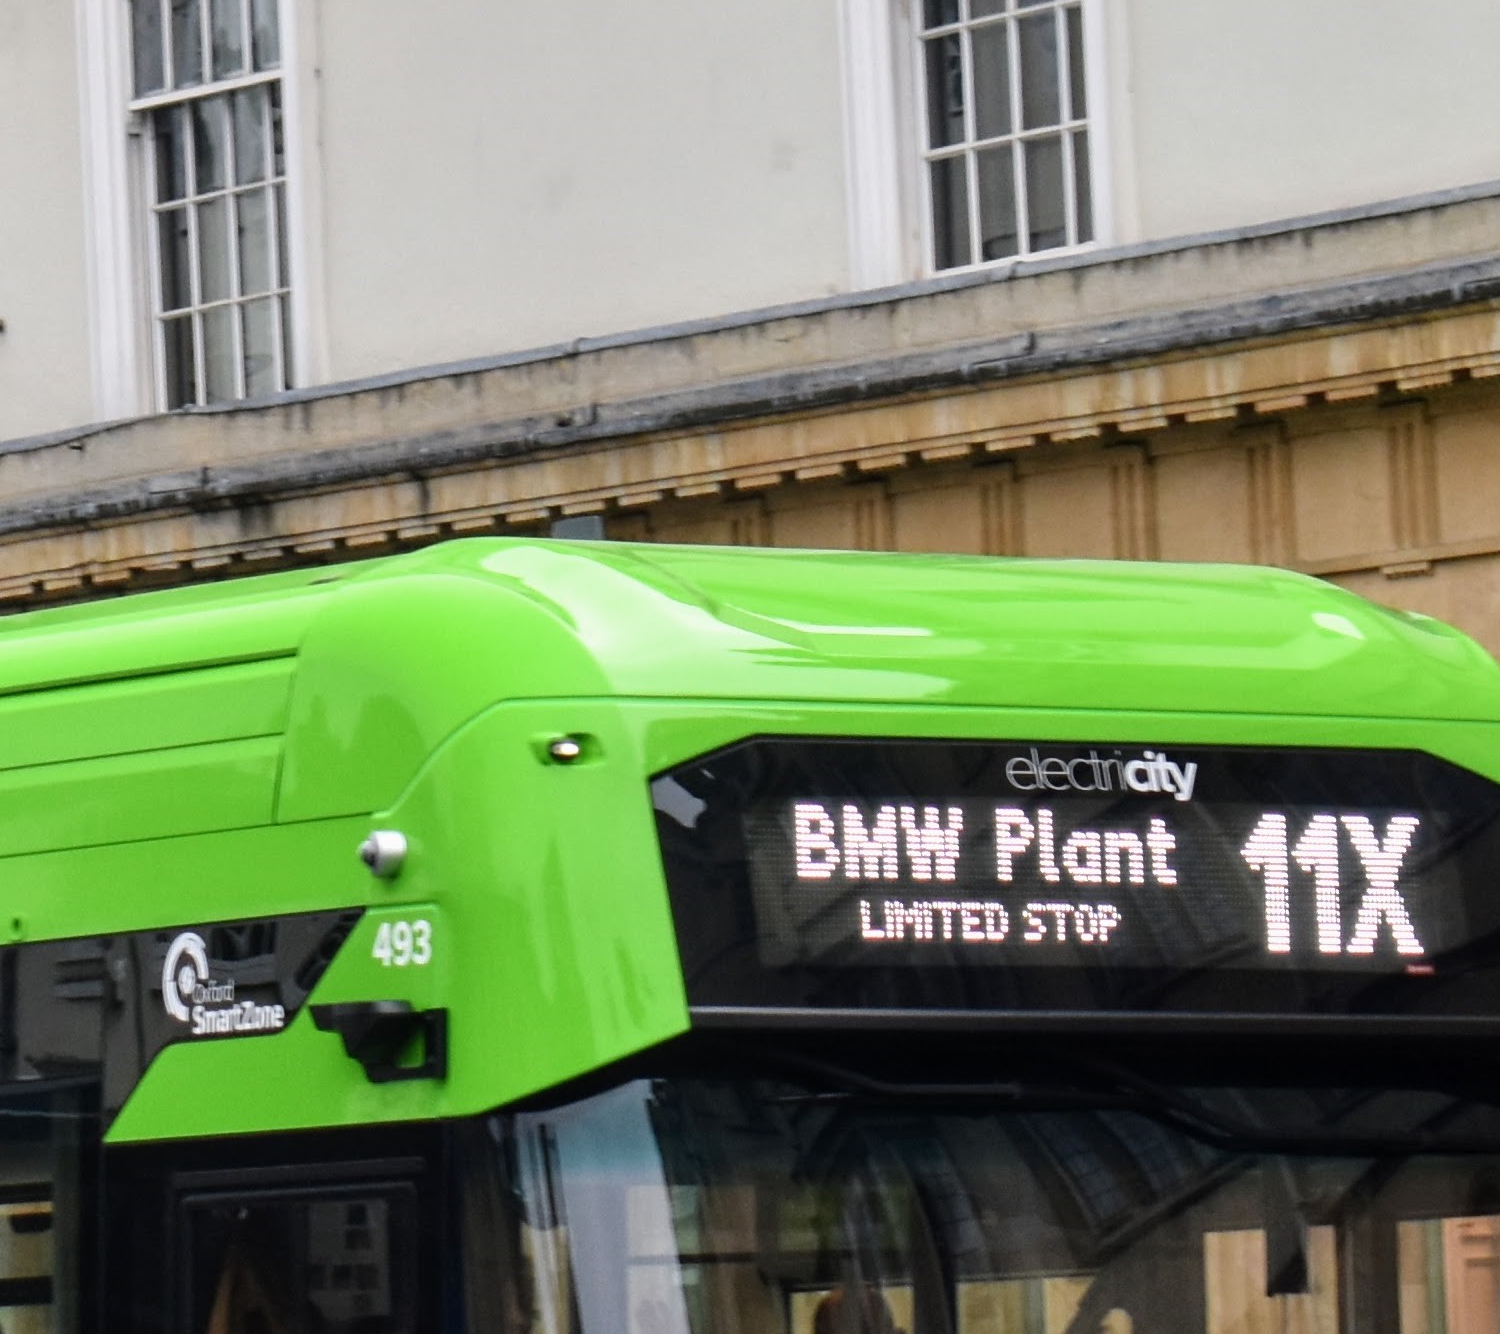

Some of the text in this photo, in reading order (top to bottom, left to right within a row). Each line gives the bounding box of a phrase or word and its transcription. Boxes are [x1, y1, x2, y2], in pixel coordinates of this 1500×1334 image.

[1004, 748, 1197, 802] electricity
[793, 803, 1178, 886] BMW Plant
[1241, 813, 1425, 955] 11X
[371, 920, 432, 967] 493
[858, 898, 1122, 945] LIMITED STOP
[193, 979, 235, 1003] Oxford
[190, 1001, 285, 1034] SmartZone
